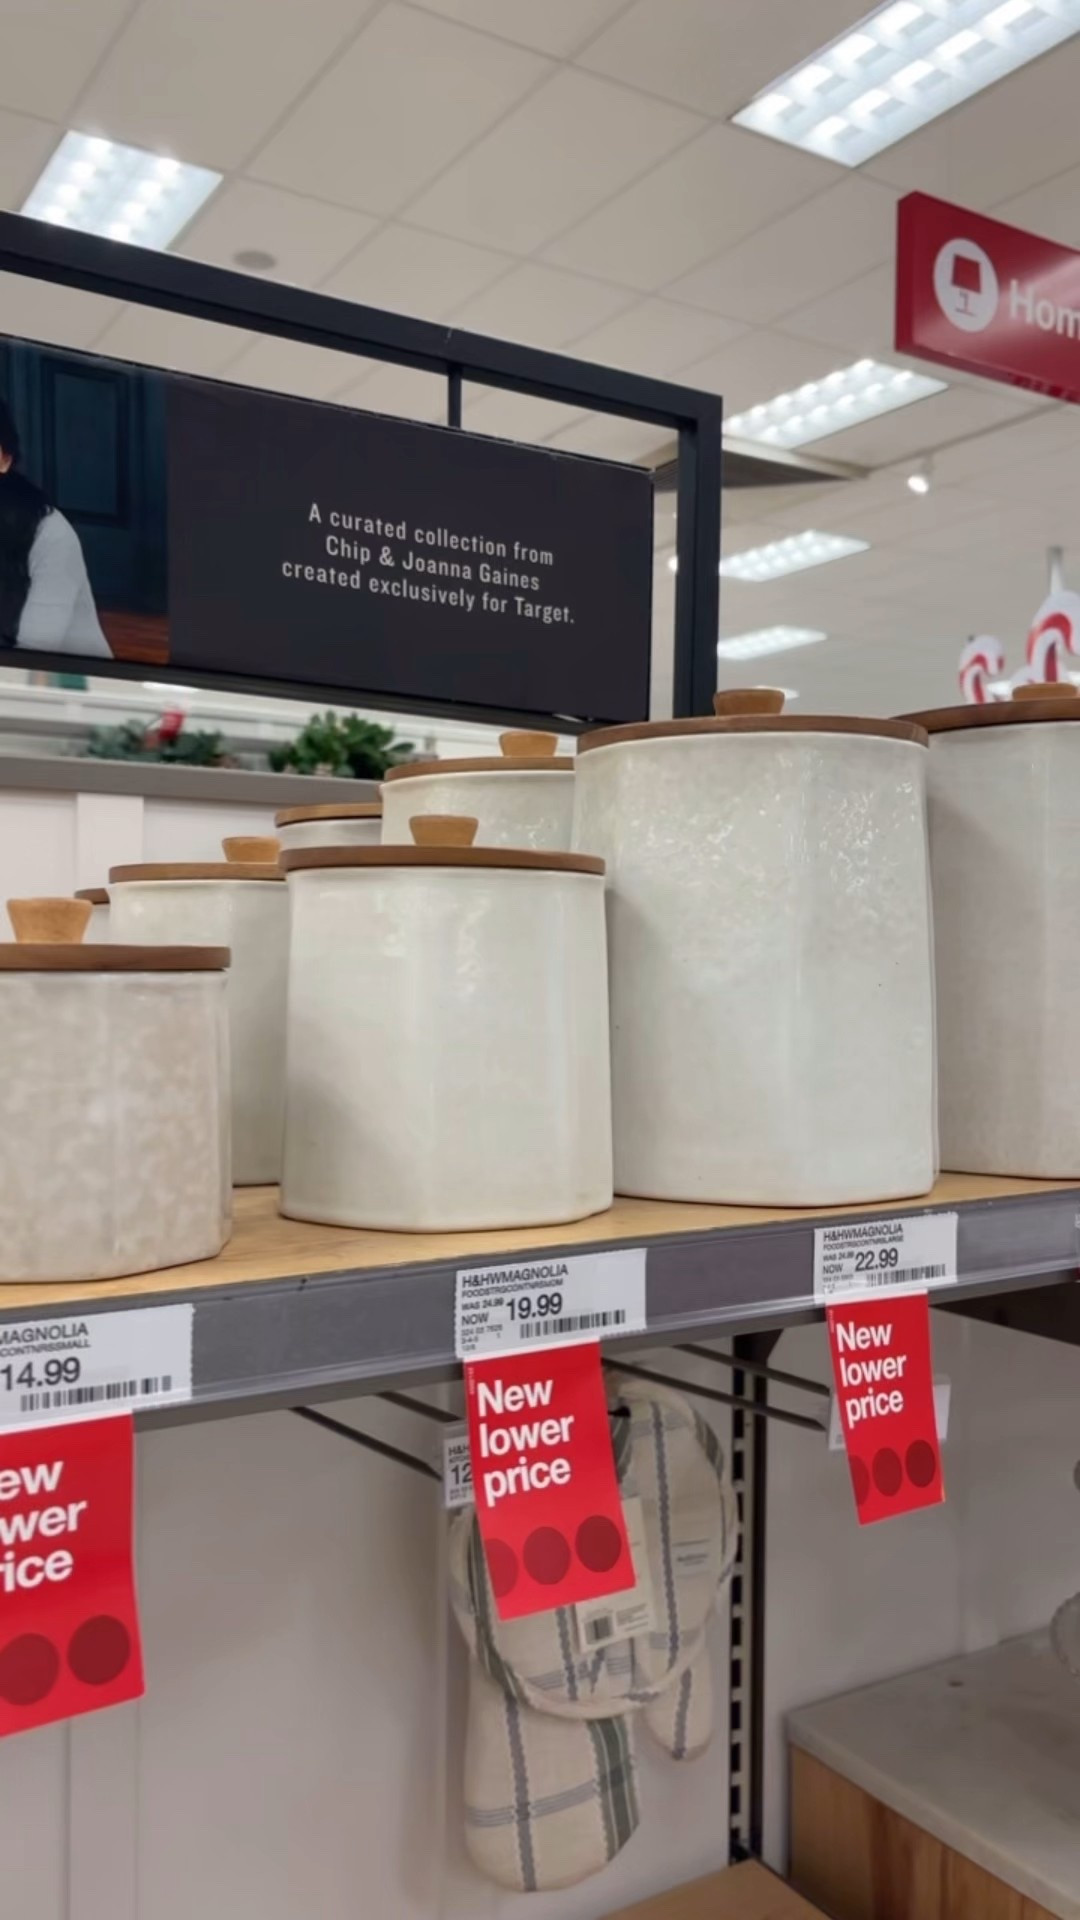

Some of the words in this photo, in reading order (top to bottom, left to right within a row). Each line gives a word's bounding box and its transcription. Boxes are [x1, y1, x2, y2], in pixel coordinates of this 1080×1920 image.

[309, 503, 322, 523] A
[329, 511, 406, 540] curated
[414, 528, 506, 558] collection
[513, 542, 554, 565] from
[325, 535, 371, 565] Chip
[379, 546, 395, 567] &
[402, 551, 472, 580] Joanna
[479, 563, 540, 591] Gaines
[281, 561, 361, 589] created
[369, 577, 475, 612] exclusively
[482, 592, 508, 613] for
[513, 597, 575, 624] Target.
[823, 1223, 903, 1242] H&HWMAGNOLIA
[462, 1264, 569, 1288] H&HWMAGNOLIA
[823, 1263, 843, 1274] NOW
[855, 1248, 898, 1272] 22.99
[462, 1312, 489, 1326] NOW
[507, 1293, 562, 1321] 19.99
[836, 1321, 892, 1352] New
[0, 1357, 81, 1391] 14.99
[839, 1355, 907, 1387] lower
[477, 1379, 552, 1417] New
[845, 1387, 904, 1429] price
[479, 1414, 574, 1458] lower
[483, 1456, 572, 1507] price
